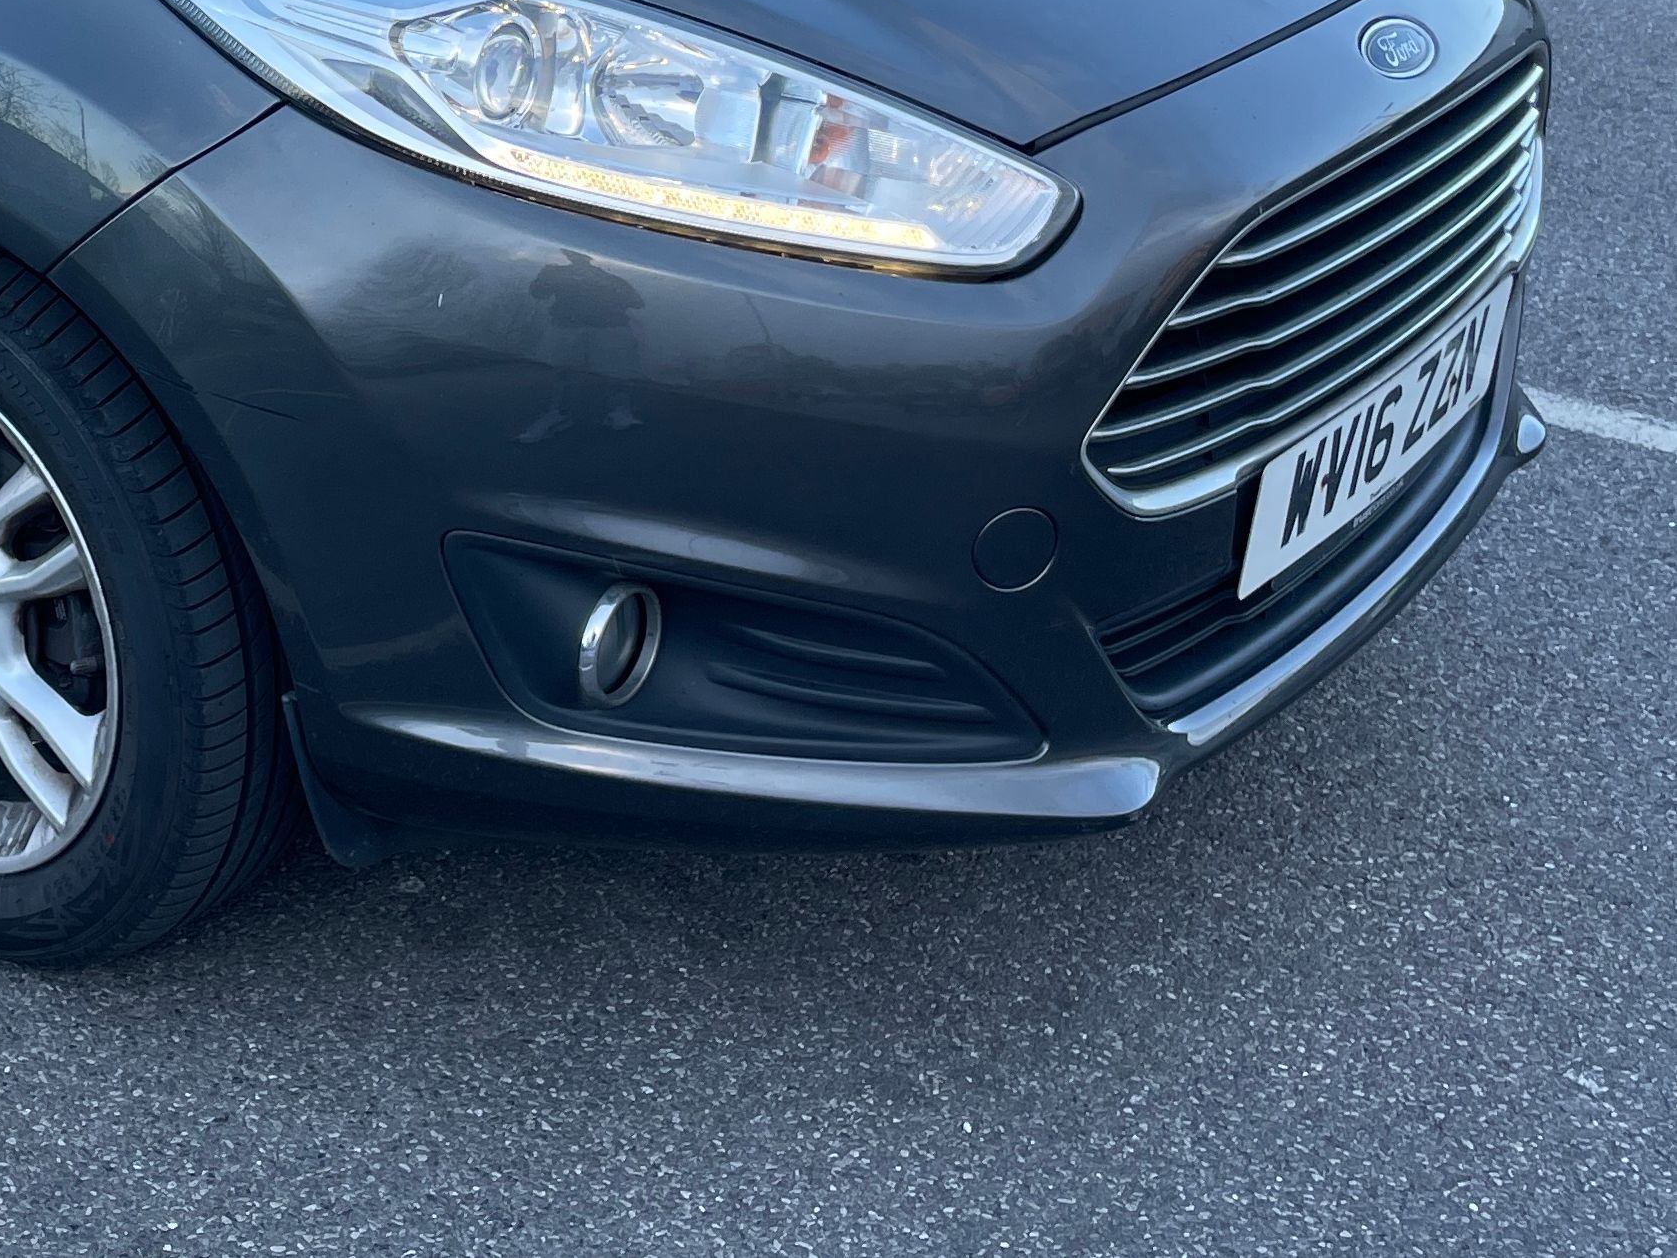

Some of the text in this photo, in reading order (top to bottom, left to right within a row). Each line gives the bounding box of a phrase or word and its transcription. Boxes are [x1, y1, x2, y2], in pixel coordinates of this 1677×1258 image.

[1377, 31, 1420, 67] Ford
[1280, 304, 1490, 549] WV16 ZZN
